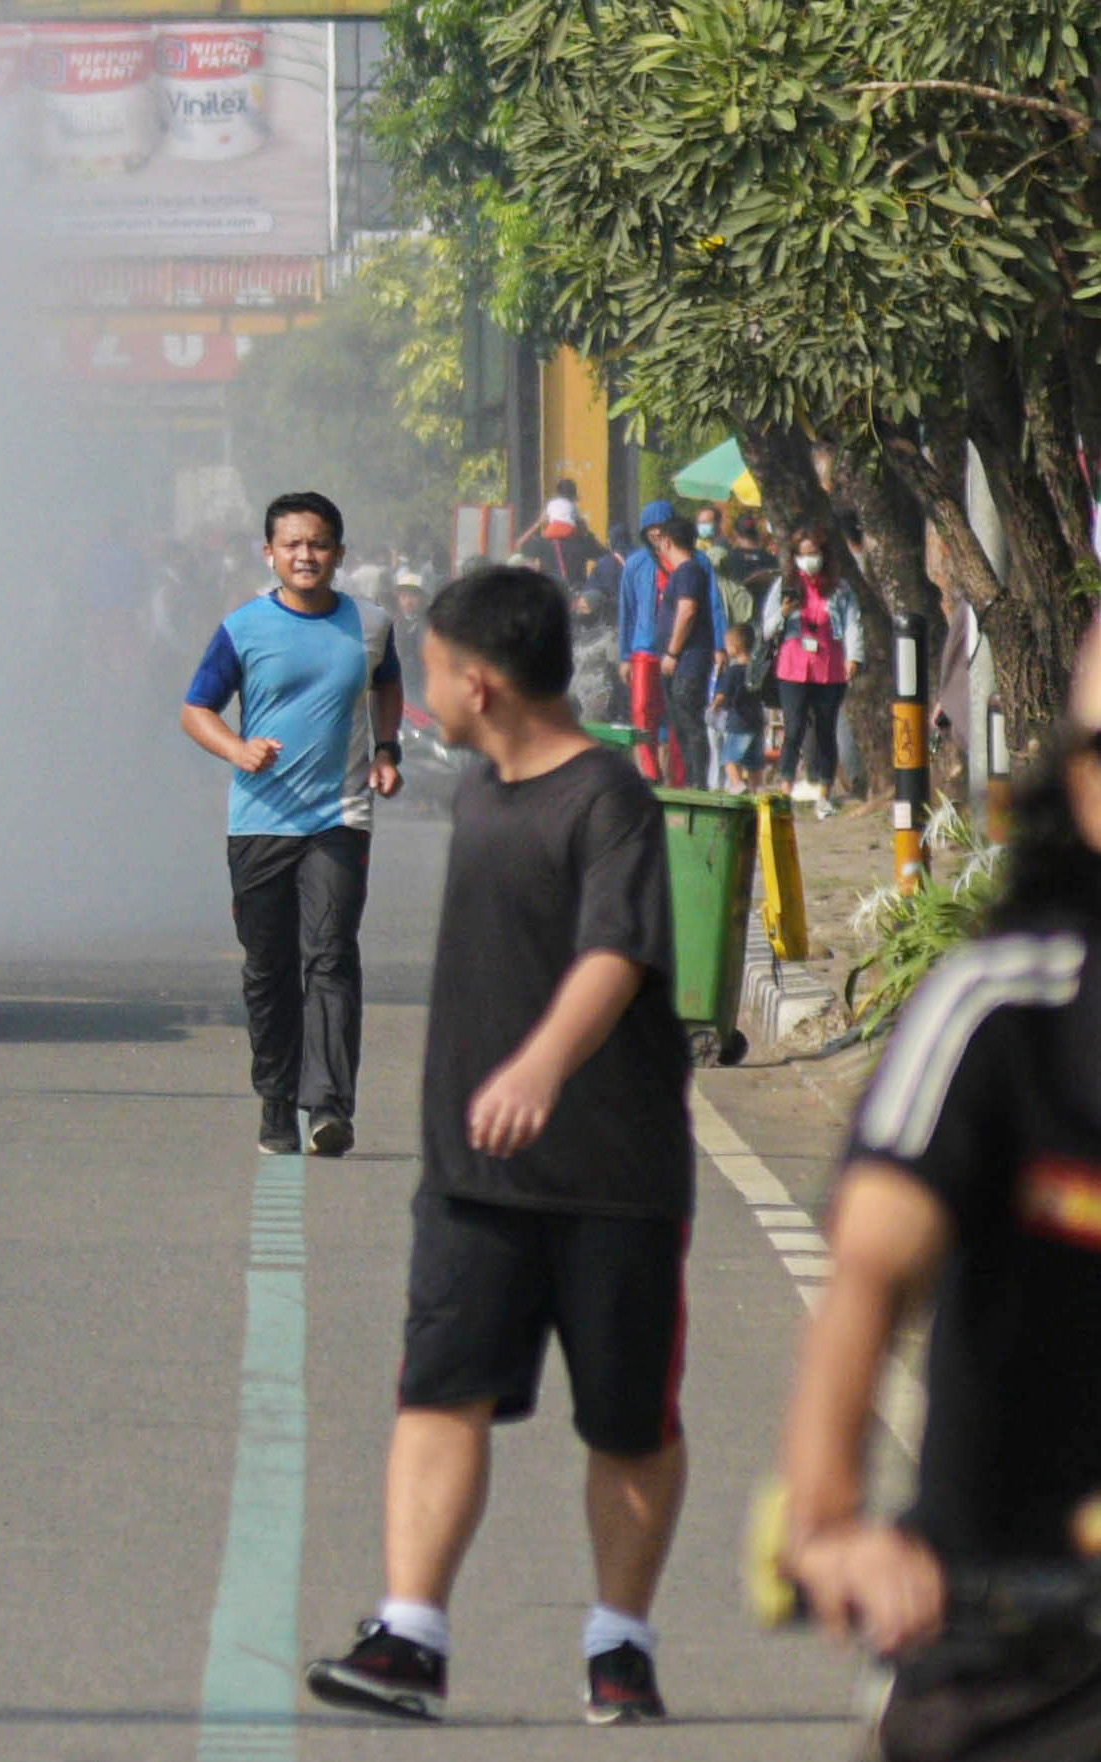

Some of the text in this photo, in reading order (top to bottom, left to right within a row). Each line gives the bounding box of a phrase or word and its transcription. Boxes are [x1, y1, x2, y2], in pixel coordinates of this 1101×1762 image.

[70, 48, 145, 66] NIPPON
[77, 64, 137, 81] PAINT
[166, 89, 249, 116] Vinilex
